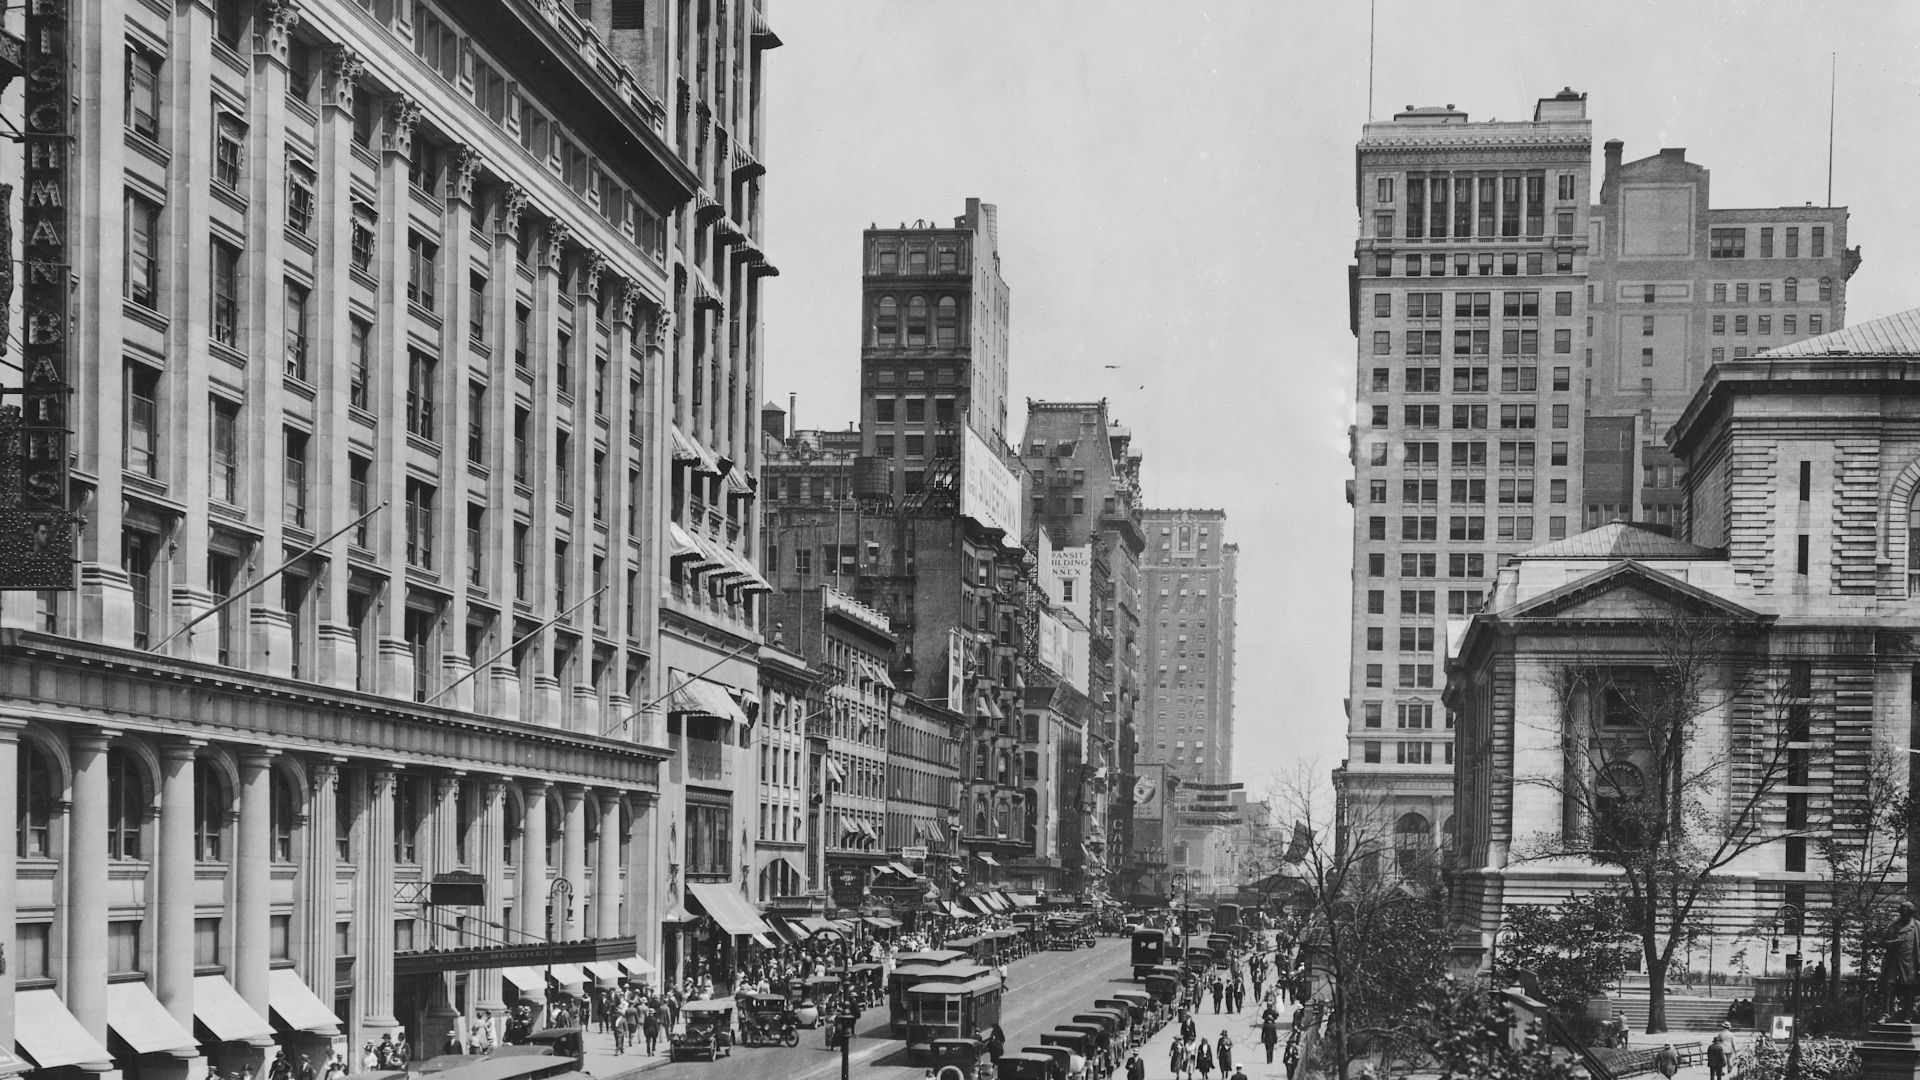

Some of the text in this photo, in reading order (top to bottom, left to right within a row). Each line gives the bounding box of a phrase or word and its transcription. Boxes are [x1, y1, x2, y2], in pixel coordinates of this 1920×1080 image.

[28, 310, 62, 499] BATHS
[1051, 551, 1084, 559] RANSIT
[1052, 568, 1081, 576] NNEX
[435, 955, 479, 963] STERN
